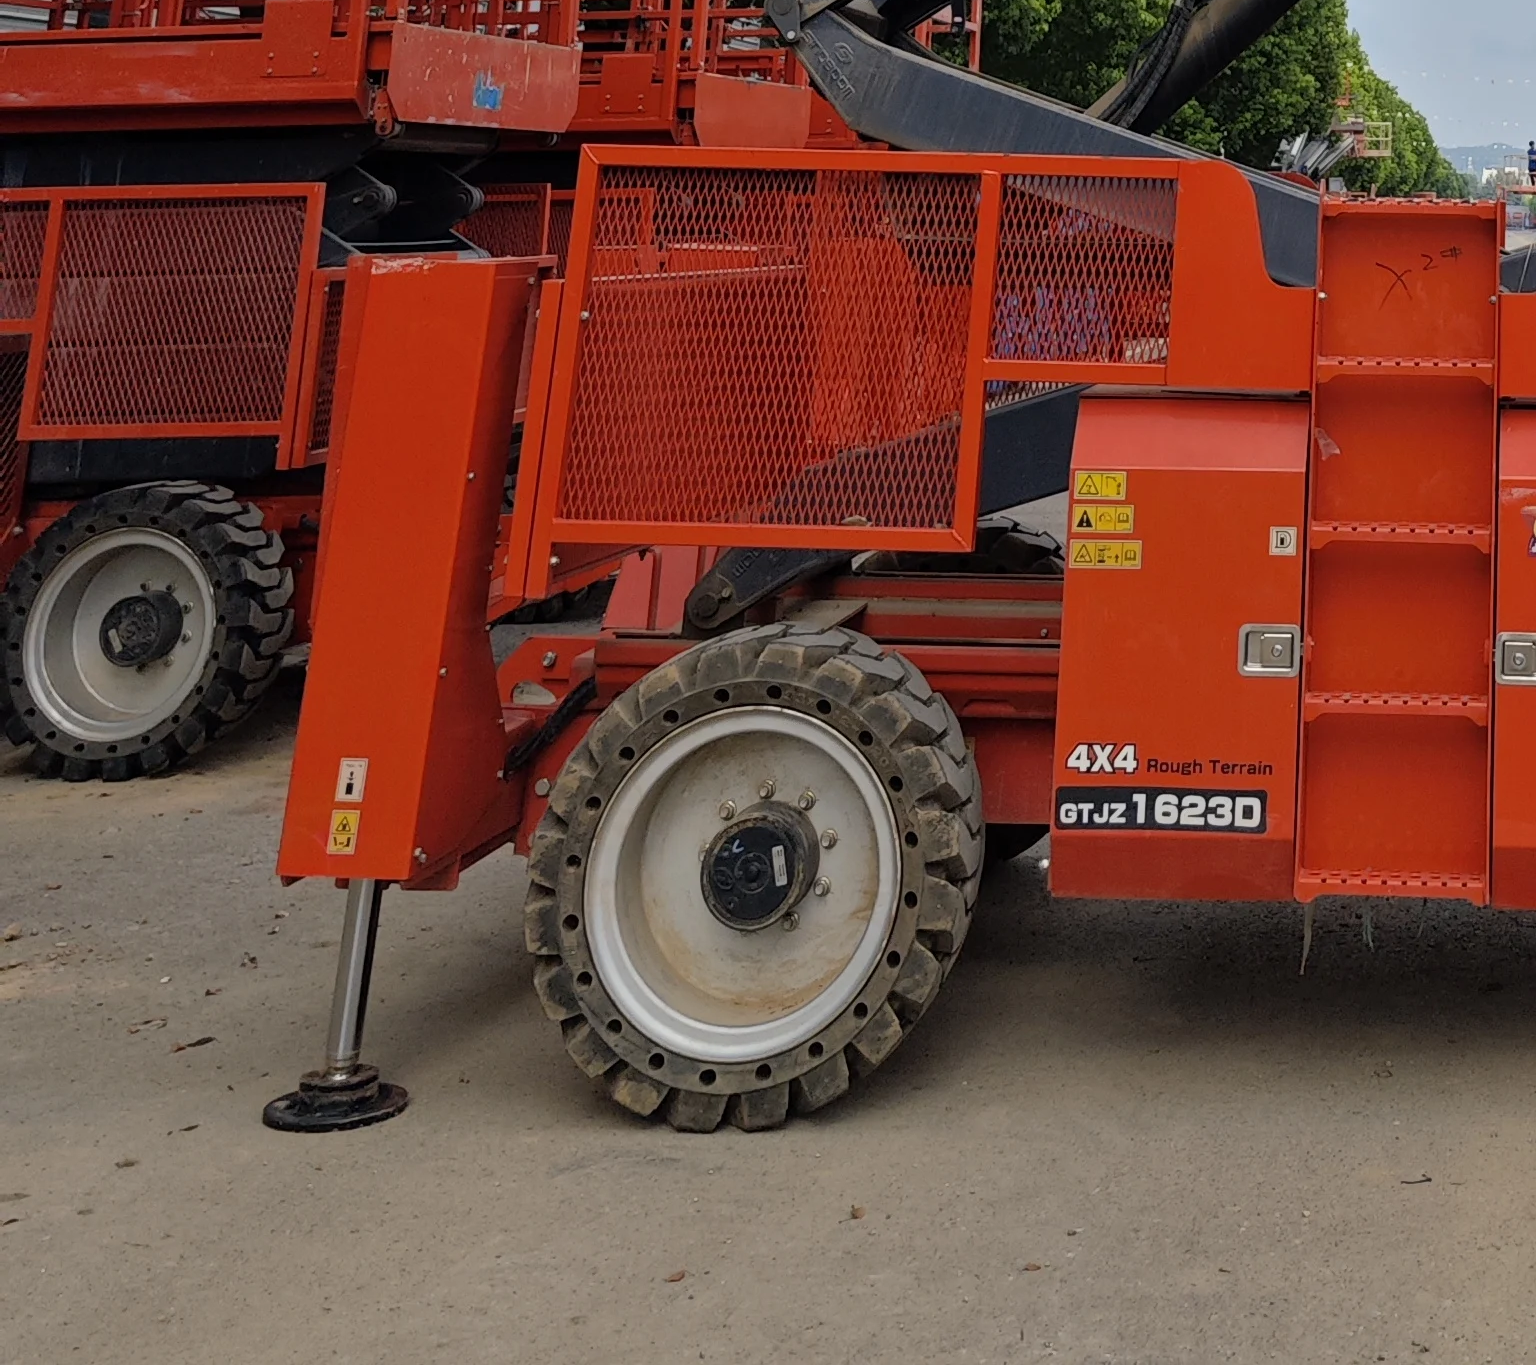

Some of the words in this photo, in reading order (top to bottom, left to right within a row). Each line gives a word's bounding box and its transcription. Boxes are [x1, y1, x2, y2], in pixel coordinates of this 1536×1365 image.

[1065, 742, 1139, 774] 4X4
[1147, 758, 1203, 776] Rough
[1209, 759, 1273, 776] Terrain
